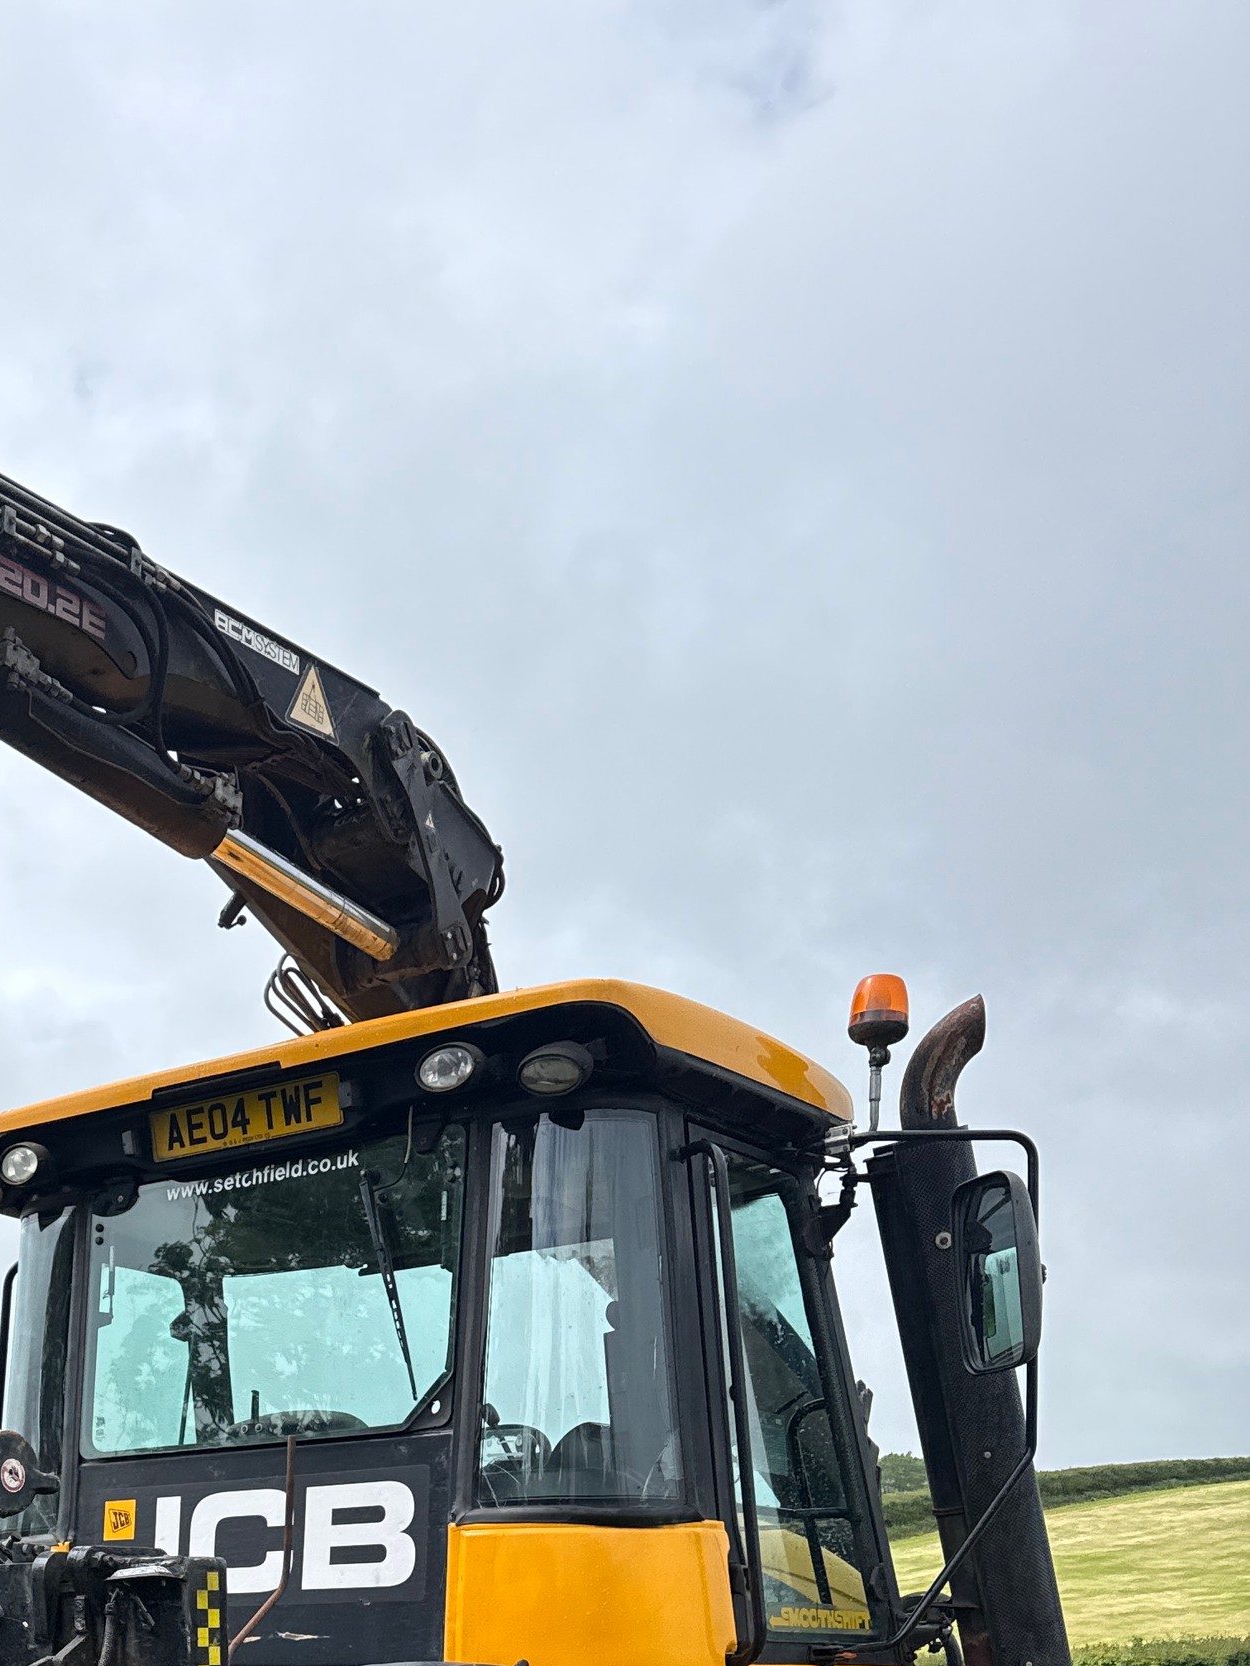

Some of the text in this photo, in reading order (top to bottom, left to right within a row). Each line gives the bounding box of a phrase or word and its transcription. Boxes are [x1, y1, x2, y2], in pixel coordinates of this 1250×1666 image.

[255, 634, 299, 674] SYSTEM
[167, 1080, 323, 1151] AE04 TWF
[167, 1149, 359, 1201] www.setchfield.co.uk
[112, 1511, 130, 1530] JCB
